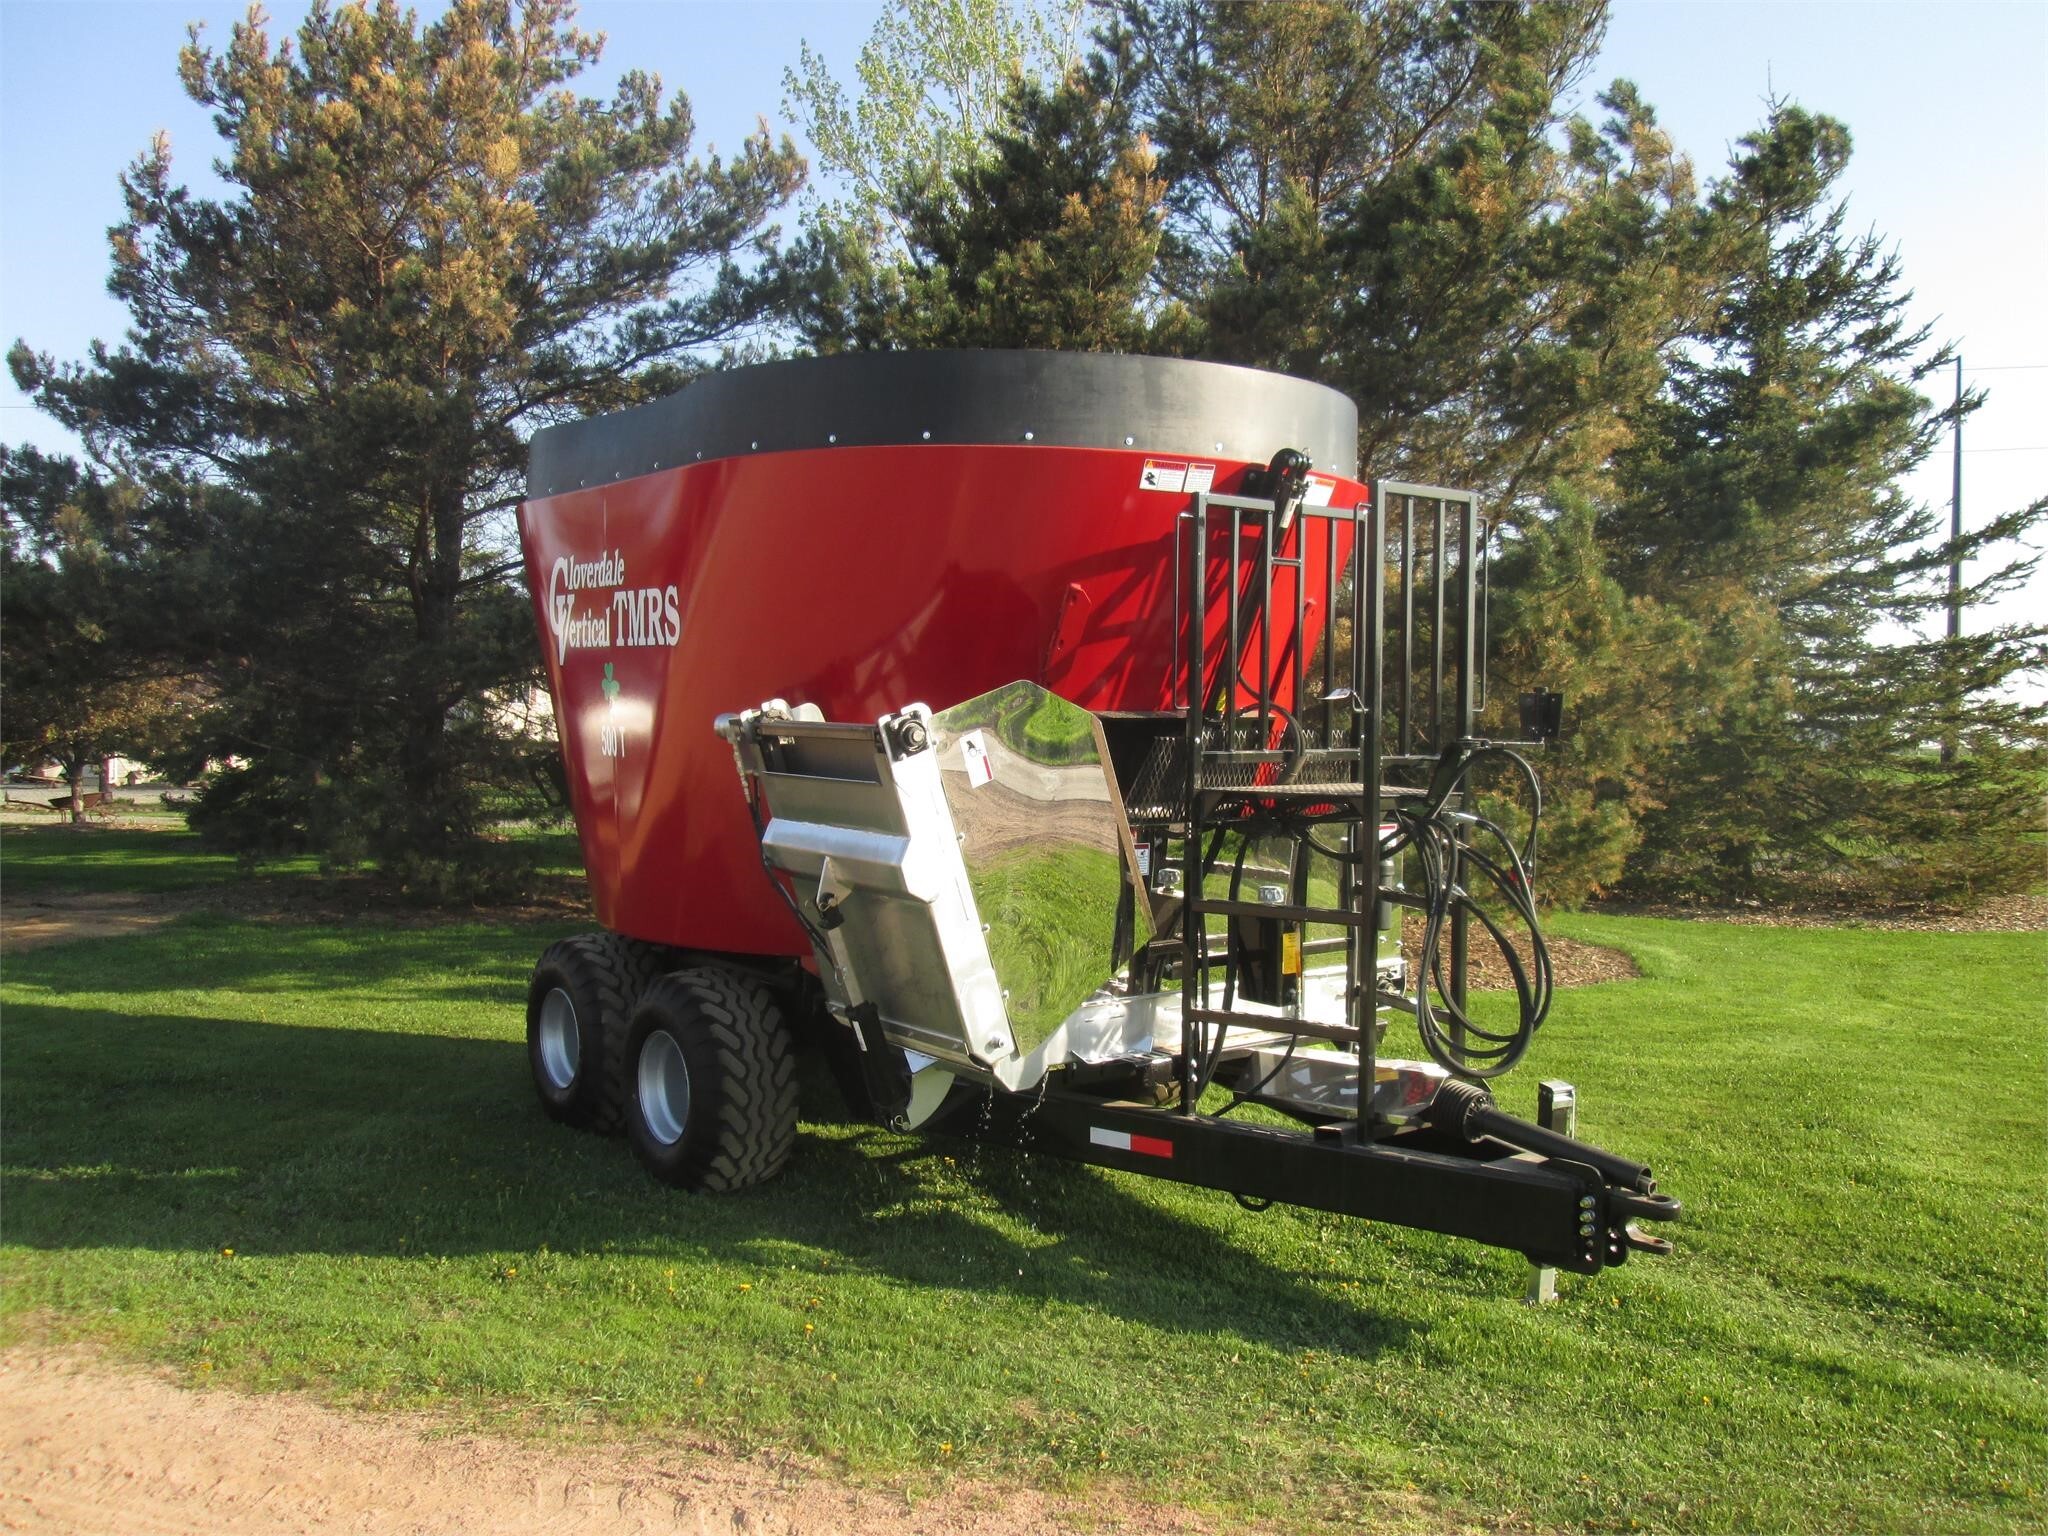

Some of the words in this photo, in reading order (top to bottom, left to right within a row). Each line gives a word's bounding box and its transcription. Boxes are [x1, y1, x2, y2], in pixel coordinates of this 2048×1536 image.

[550, 548, 625, 634] Cloverdale
[556, 593, 611, 665] Vertical
[613, 585, 681, 646] TMRS
